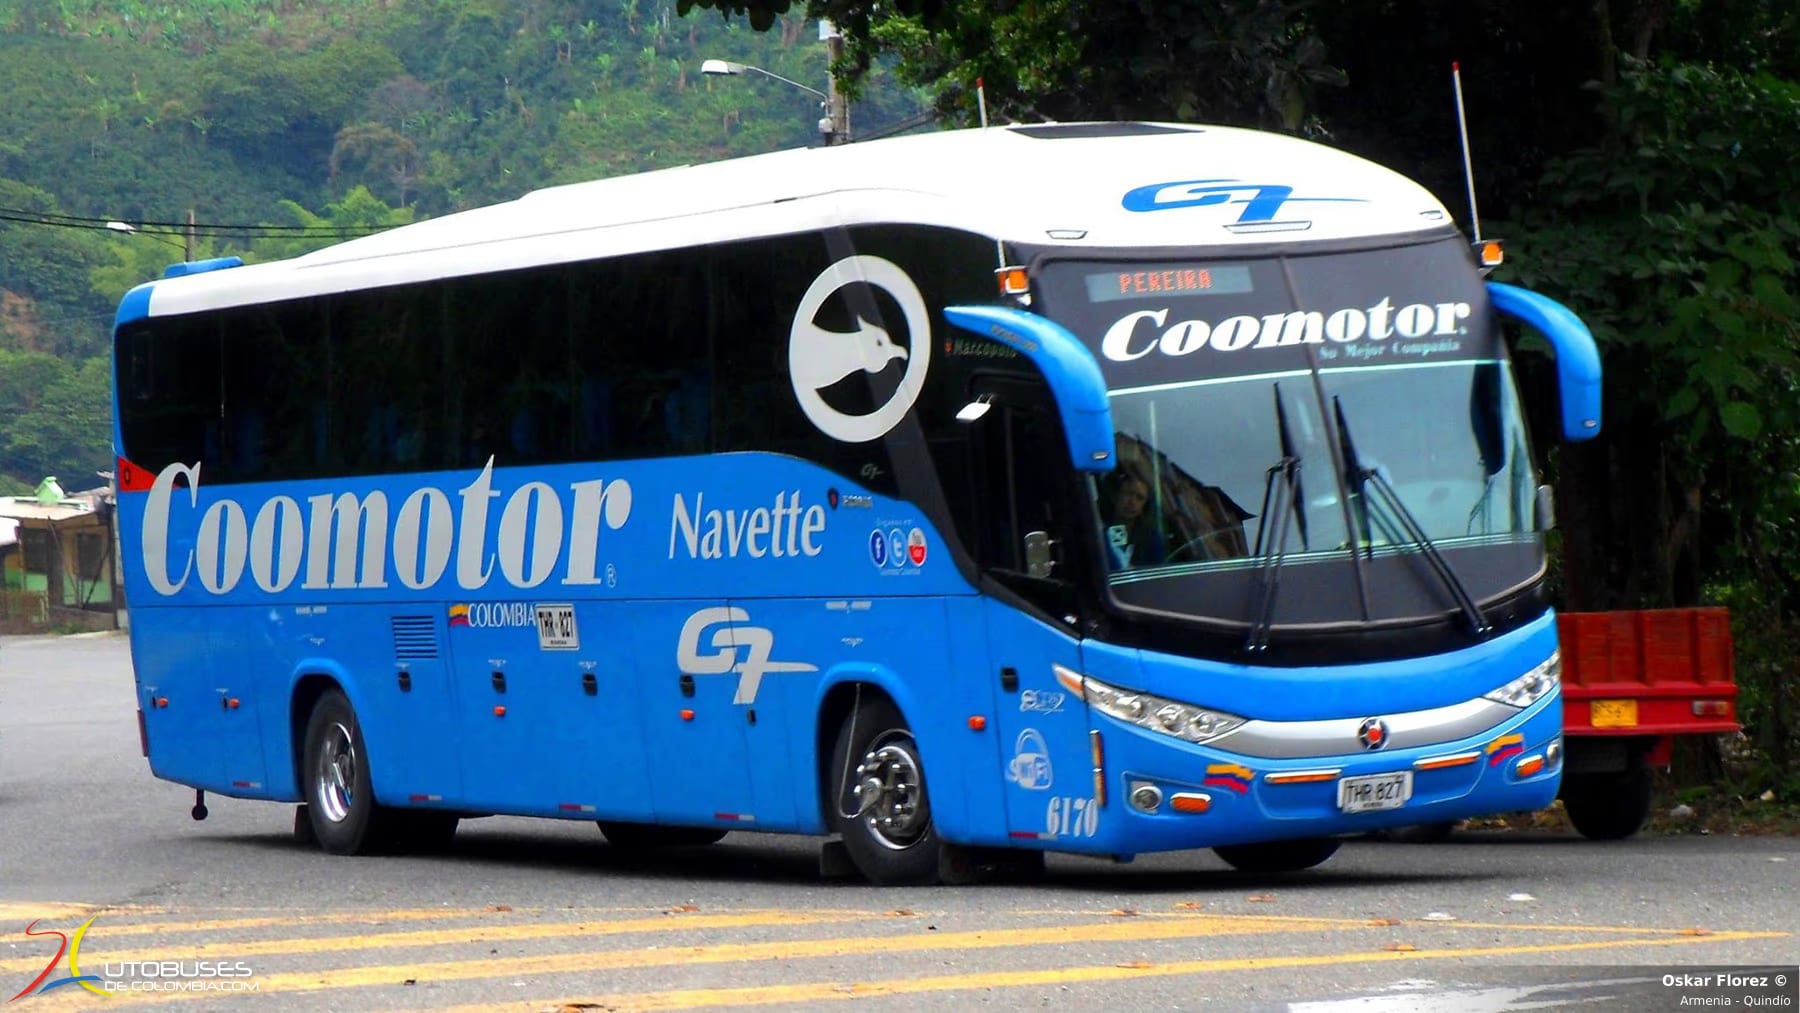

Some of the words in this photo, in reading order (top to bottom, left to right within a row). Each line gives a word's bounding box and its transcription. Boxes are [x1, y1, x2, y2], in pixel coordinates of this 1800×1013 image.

[1119, 268, 1213, 294] PEREIRA
[1102, 297, 1471, 361] Coomotor
[1345, 343, 1386, 360] Mejor
[142, 454, 632, 596] Coomotor
[668, 489, 825, 560] Navette
[467, 602, 537, 628] COLOMBIA
[1345, 781, 1372, 803] THR
[1376, 777, 1404, 801] 827
[1046, 796, 1099, 838] 6170
